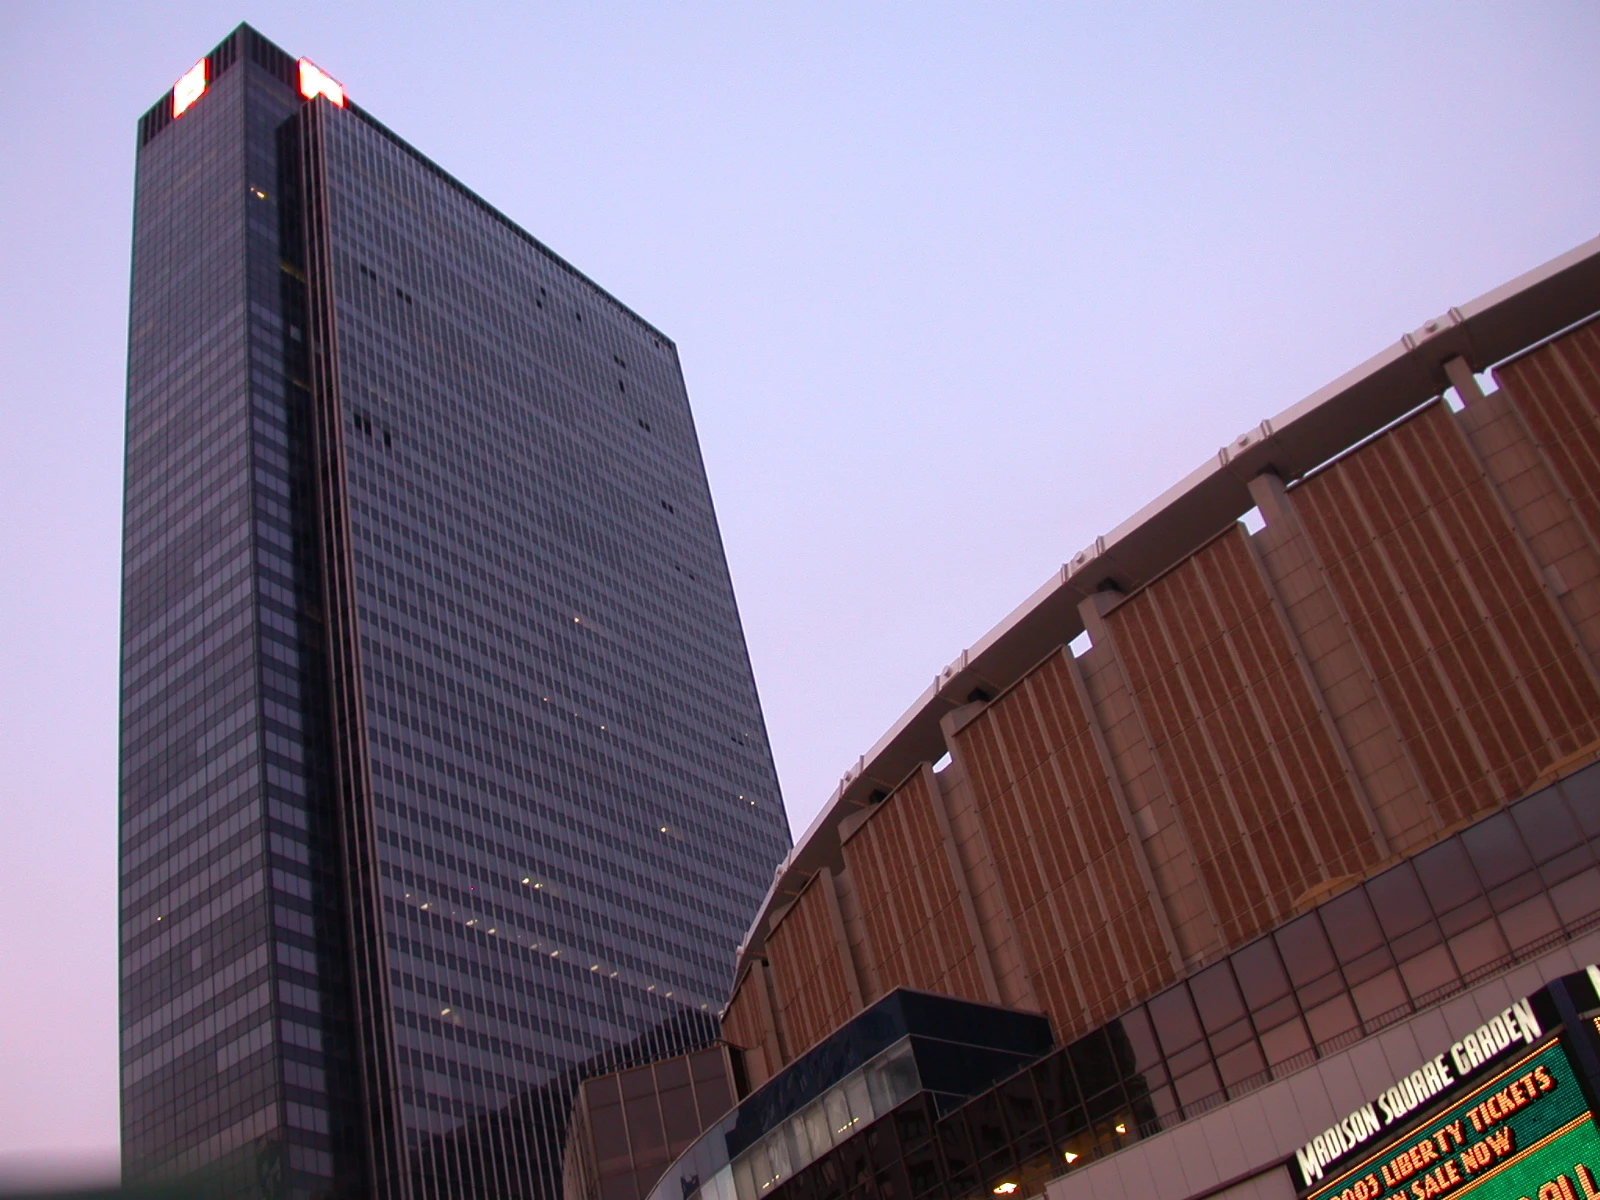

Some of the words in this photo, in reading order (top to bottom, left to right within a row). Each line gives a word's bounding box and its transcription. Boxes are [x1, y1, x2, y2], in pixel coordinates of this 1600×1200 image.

[1295, 1102, 1381, 1187] MADISON
[1377, 1053, 1454, 1126] SQUARE
[1450, 997, 1543, 1076] GARDEN
[1380, 1119, 1465, 1188] LIBERTY
[1465, 1065, 1556, 1132] TICKETS
[1411, 1159, 1464, 1200] SALE
[1460, 1126, 1512, 1174] NOW
